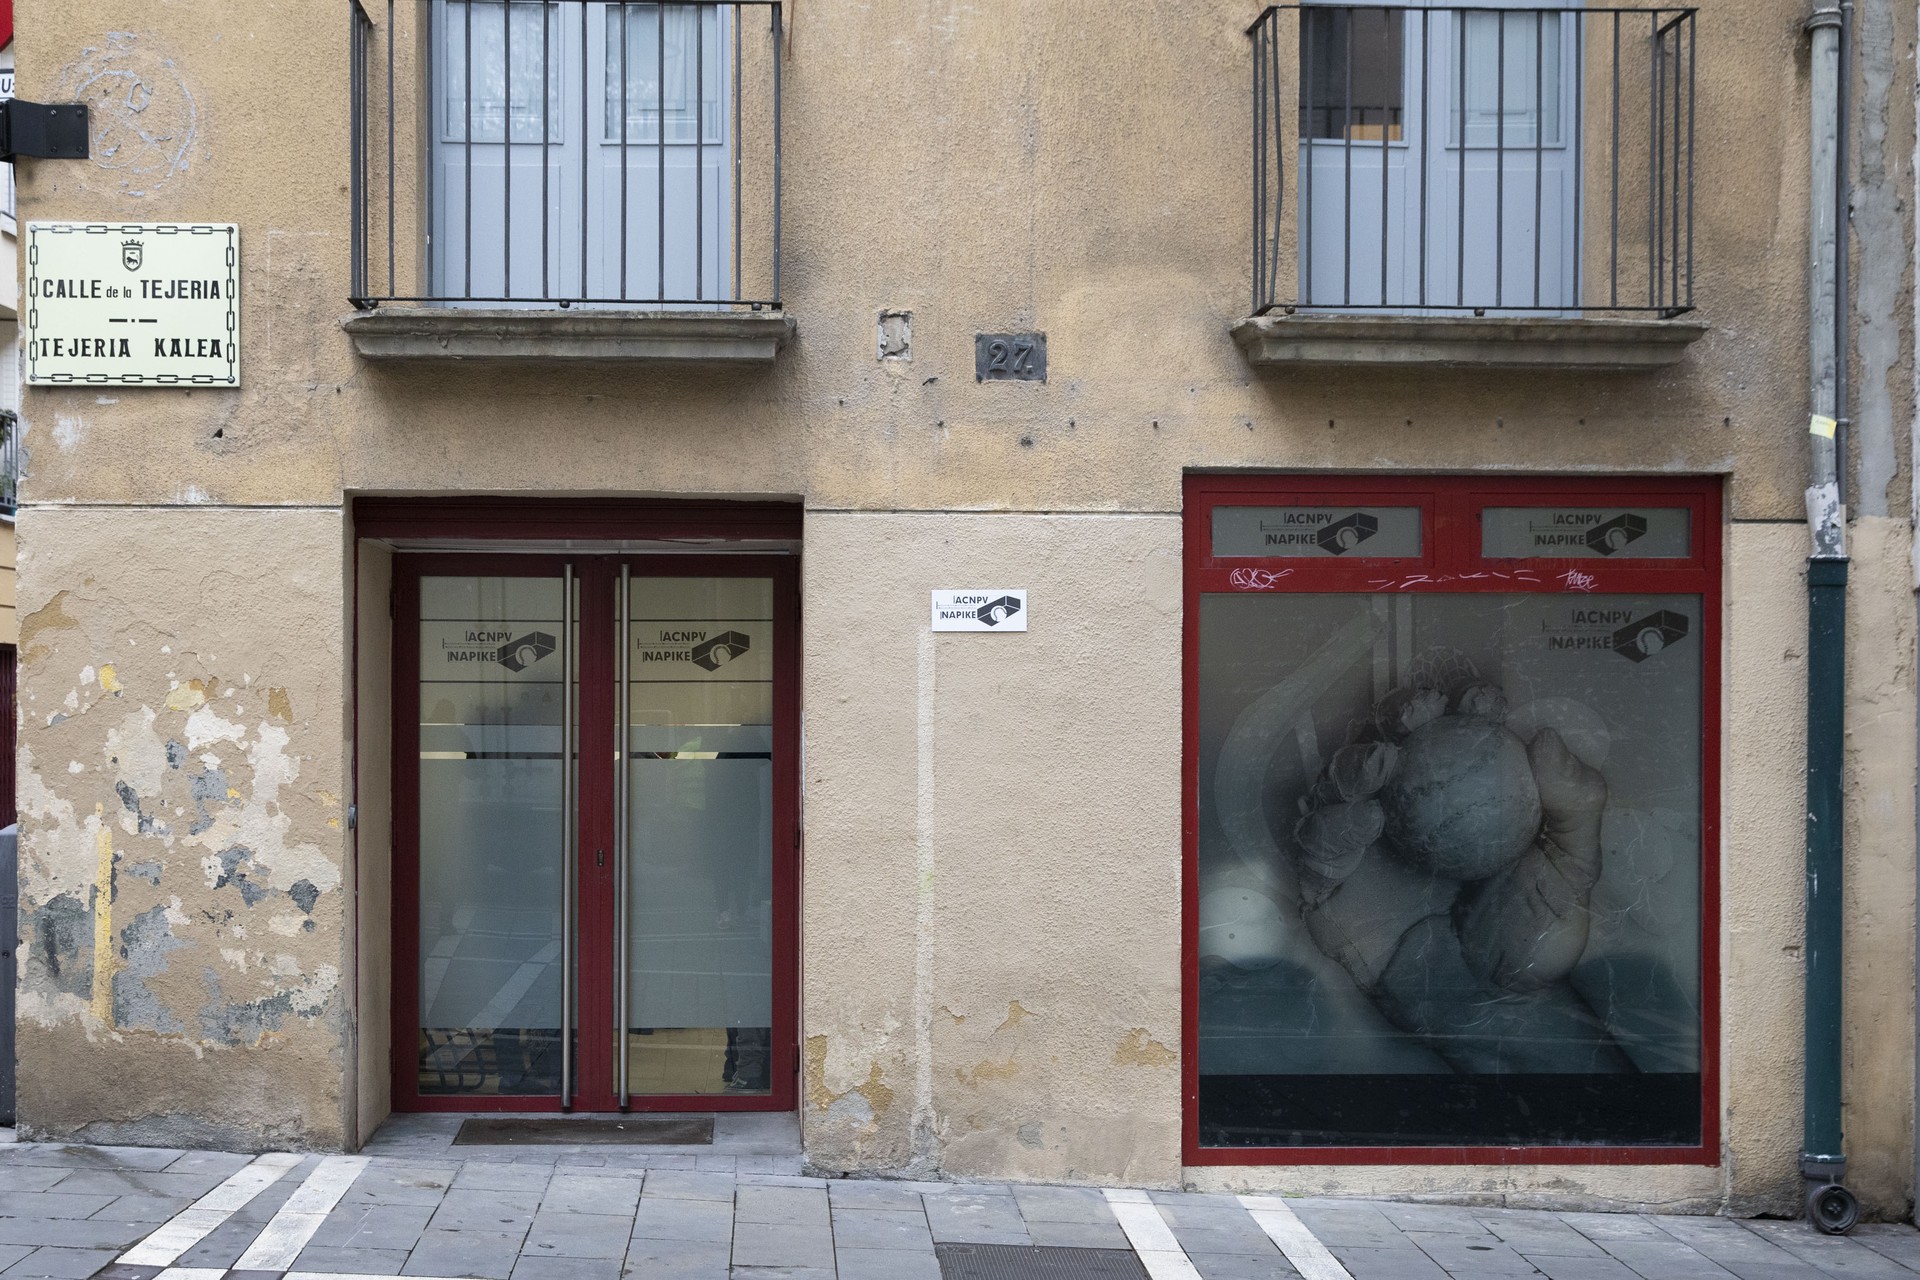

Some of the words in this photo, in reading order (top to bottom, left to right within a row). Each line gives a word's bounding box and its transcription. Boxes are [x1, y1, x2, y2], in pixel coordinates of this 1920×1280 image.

[42, 279, 102, 299] CALLE
[106, 286, 119, 298] de
[123, 286, 132, 298] la
[140, 279, 221, 300] TEJERIA
[39, 338, 131, 358] TEJERIA
[154, 338, 223, 358] KALEA
[1286, 513, 1333, 524] ACNPV
[1556, 514, 1602, 525] ACNPV
[1268, 534, 1316, 545] NAPIKE
[1537, 535, 1585, 545] NAPIKE
[955, 596, 988, 604] ACNPV
[941, 611, 976, 619] NAPIKE
[1575, 611, 1632, 623] ACNPV
[468, 632, 512, 642] ACNPV
[662, 631, 706, 641] ACNPV
[1551, 636, 1612, 649] NAPIKE
[449, 651, 496, 662] NAPIKE
[644, 651, 691, 661] NAPIKE
